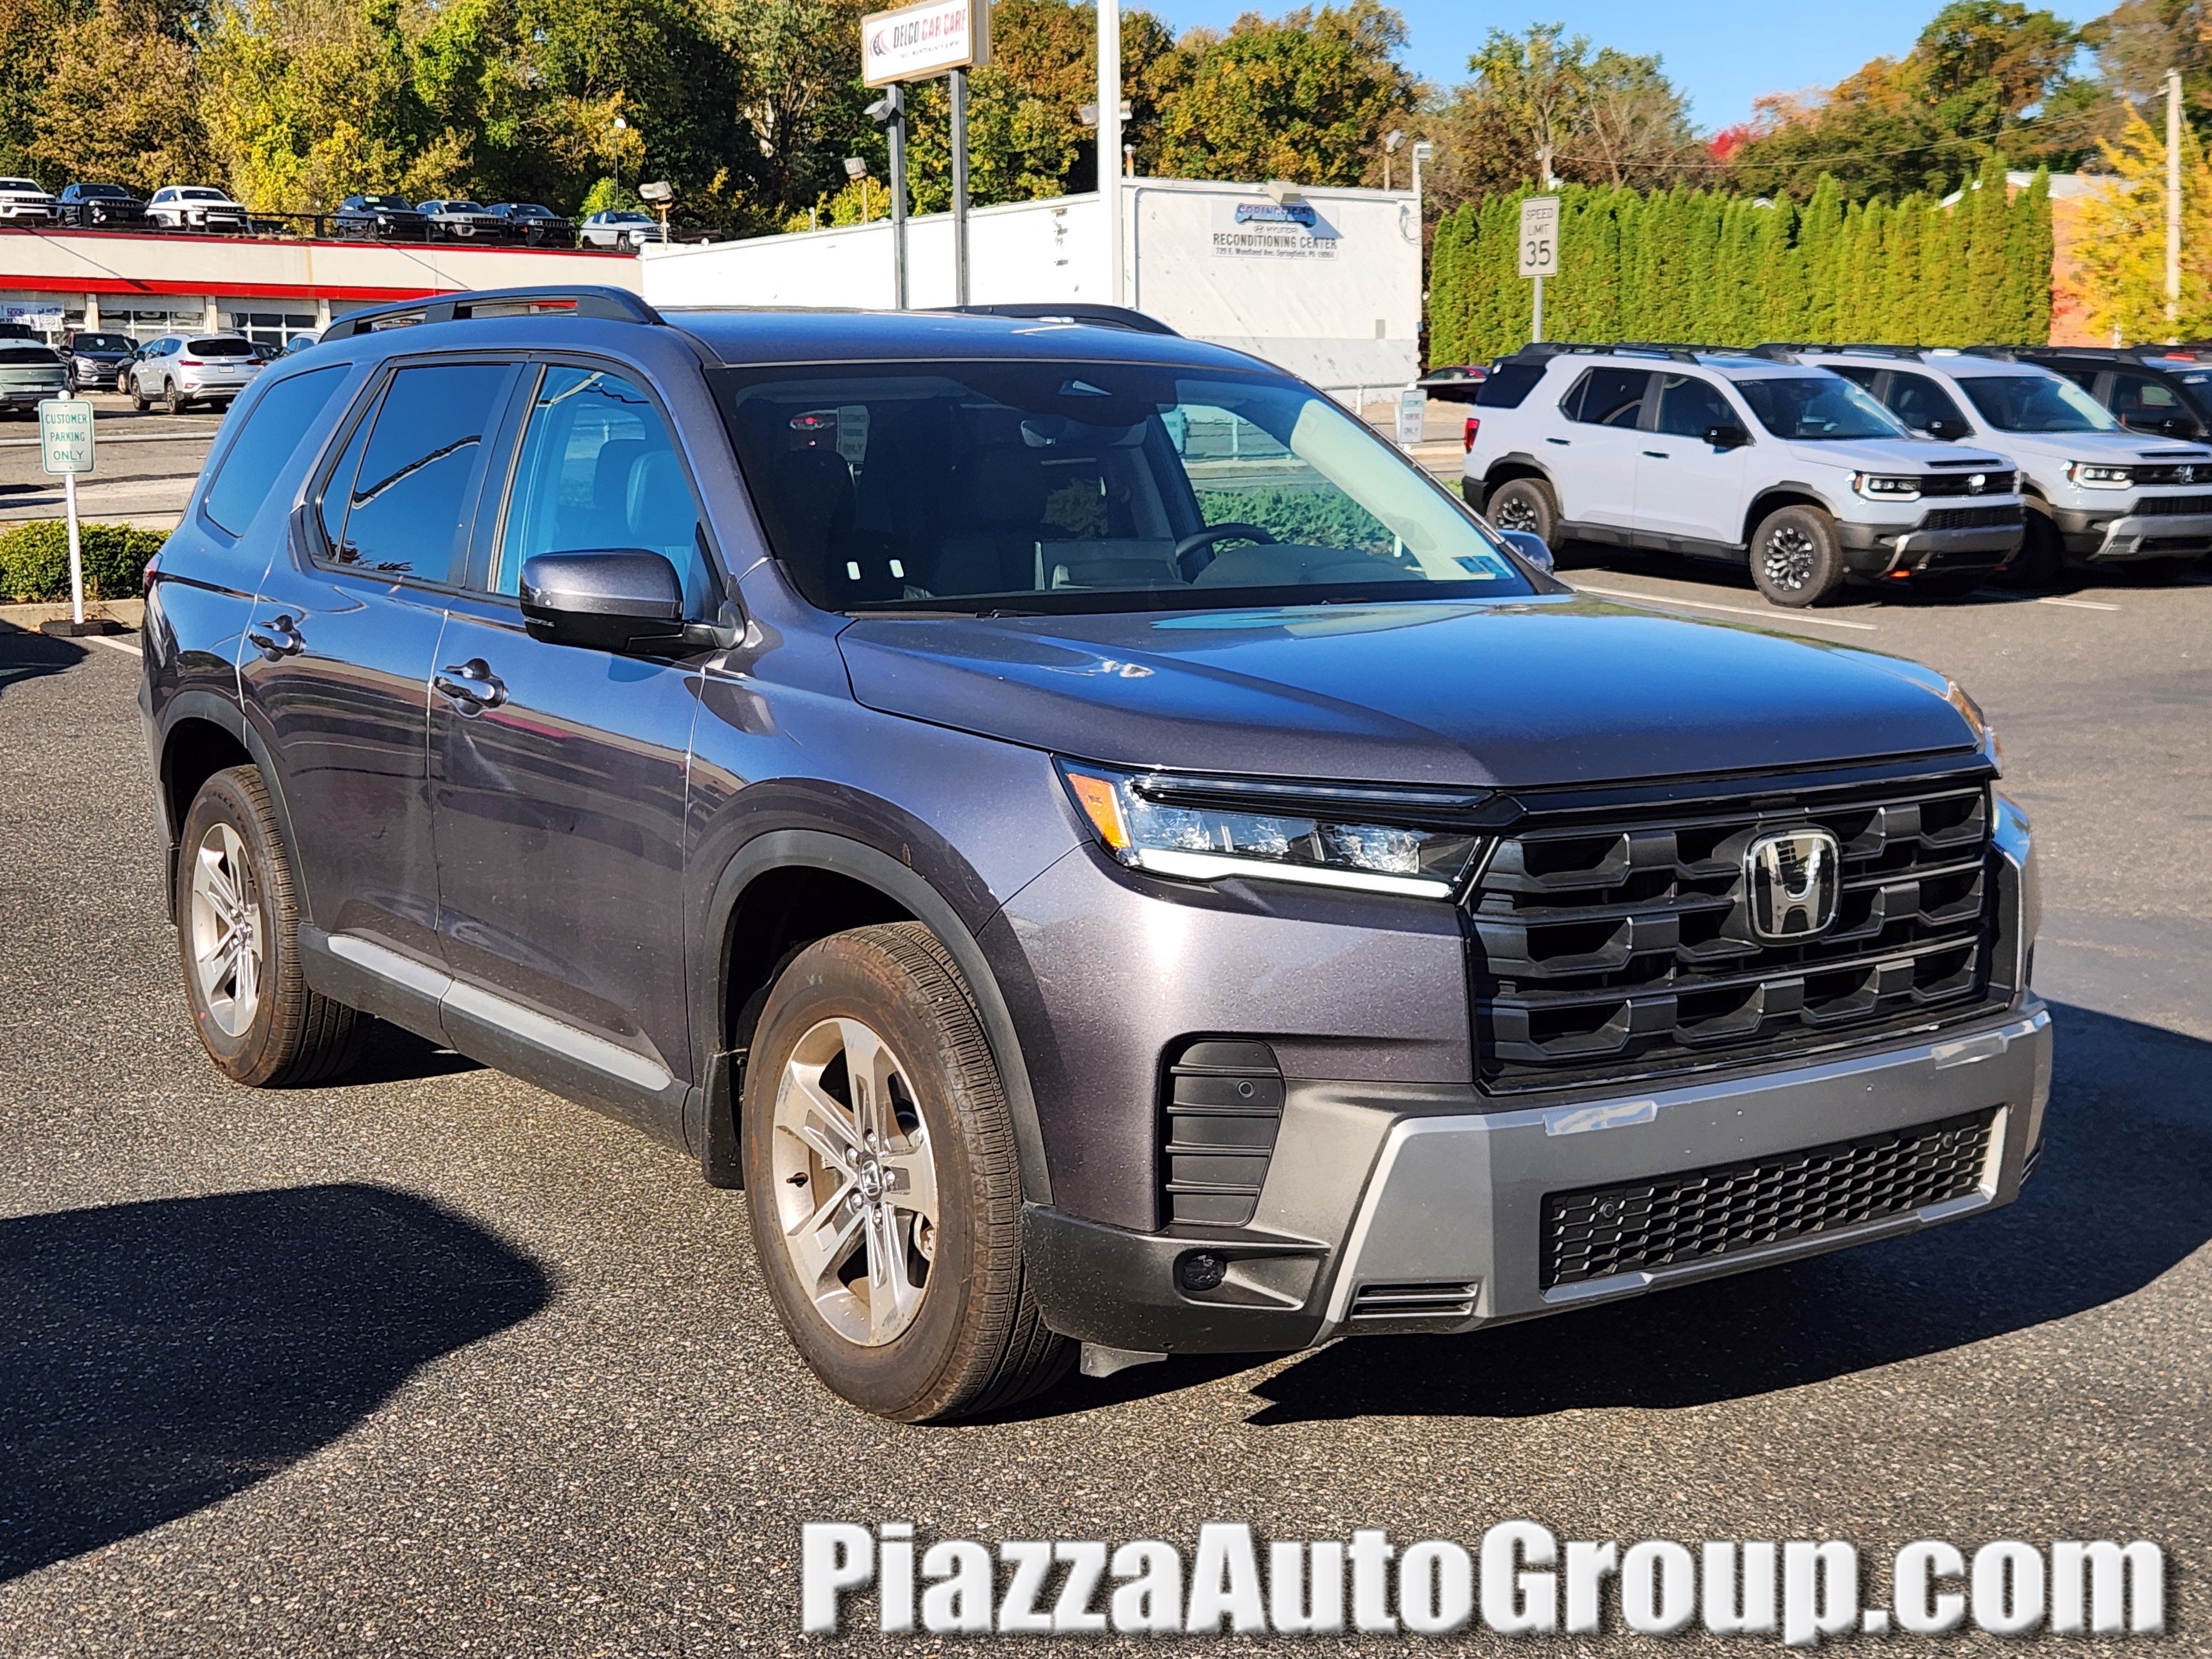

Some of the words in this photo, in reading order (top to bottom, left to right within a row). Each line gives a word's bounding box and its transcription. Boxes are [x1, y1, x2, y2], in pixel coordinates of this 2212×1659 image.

[894, 20, 920, 49] DELCO
[922, 16, 941, 41] CAR
[944, 8, 967, 36] CARE
[1526, 207, 1553, 221] SPEED
[1527, 223, 1550, 236] LIMIT
[1213, 233, 1296, 248] RECONDITIONING
[1300, 236, 1337, 249] CENTER
[1525, 240, 1551, 267] 35
[45, 414, 87, 424] CUSTOMER
[50, 432, 85, 442] PARKING
[53, 450, 84, 460] ONLY
